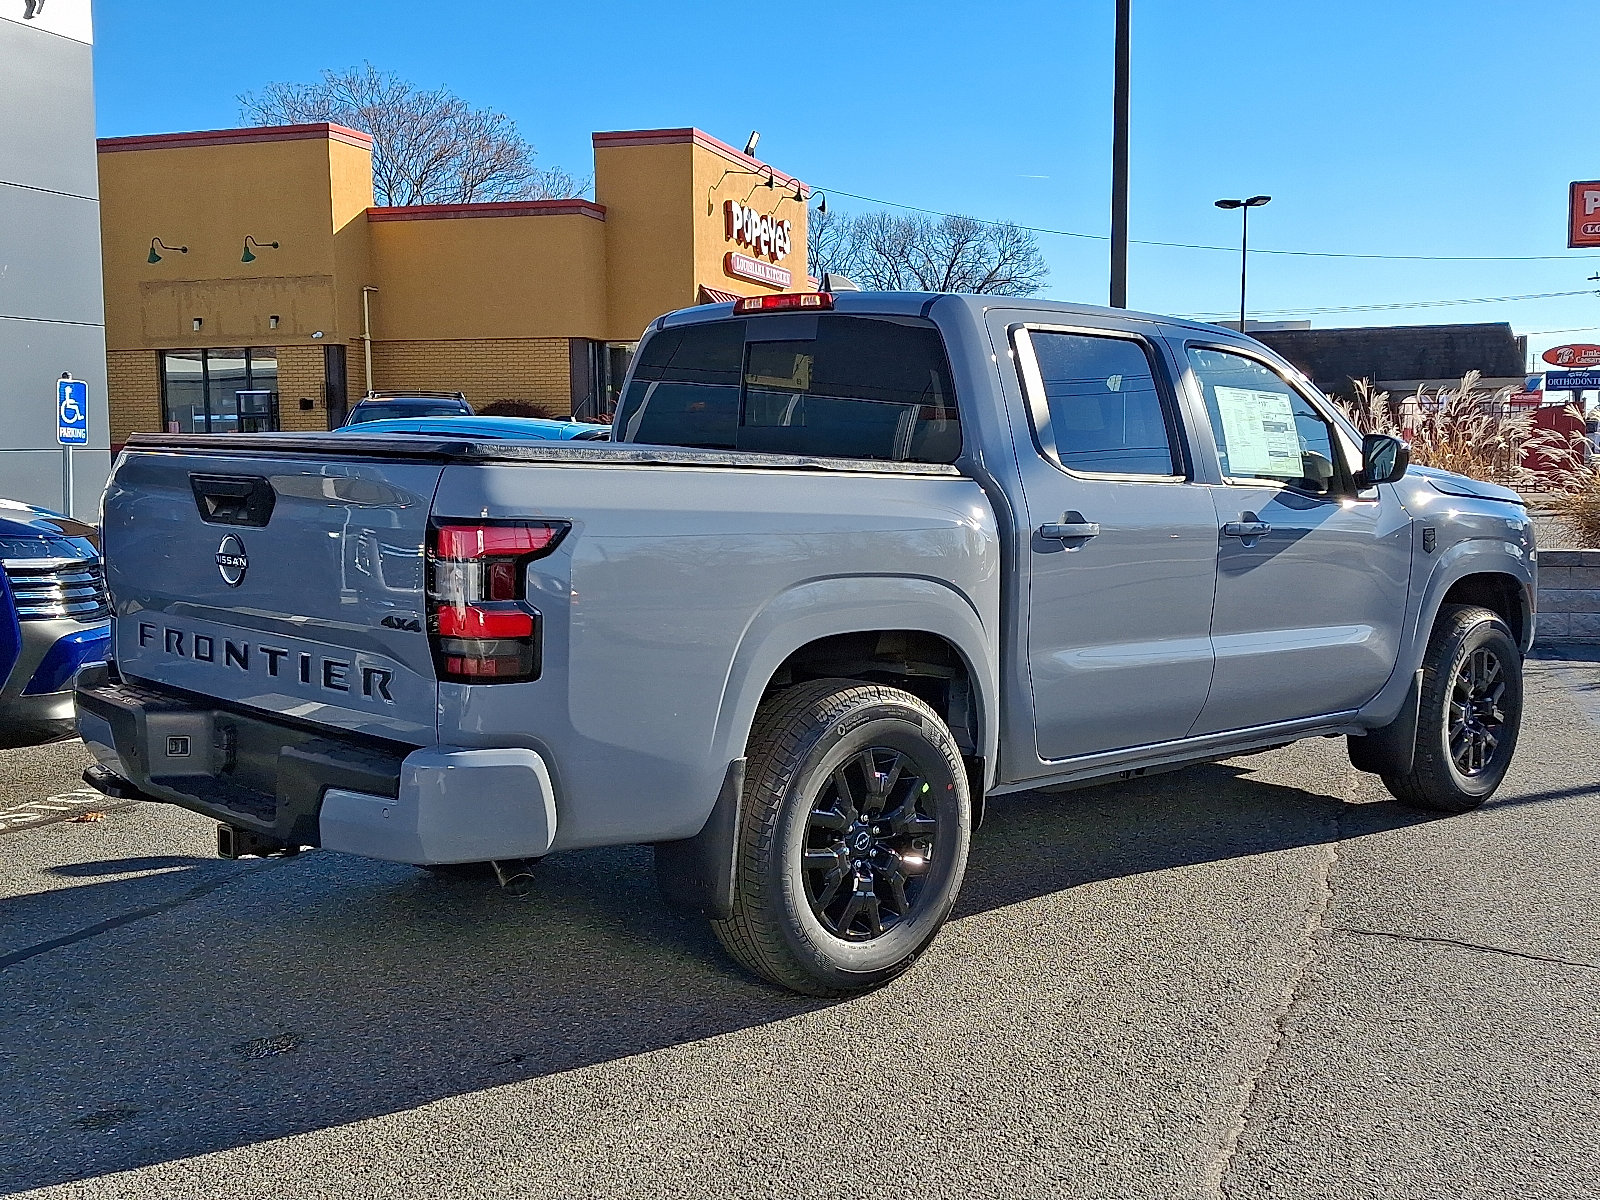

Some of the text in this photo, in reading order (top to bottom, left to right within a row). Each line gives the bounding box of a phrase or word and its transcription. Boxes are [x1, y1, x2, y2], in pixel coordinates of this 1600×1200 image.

[60, 427, 86, 439] PARKING
[215, 554, 247, 567] NISSAN
[138, 622, 396, 705] FRONTIER
